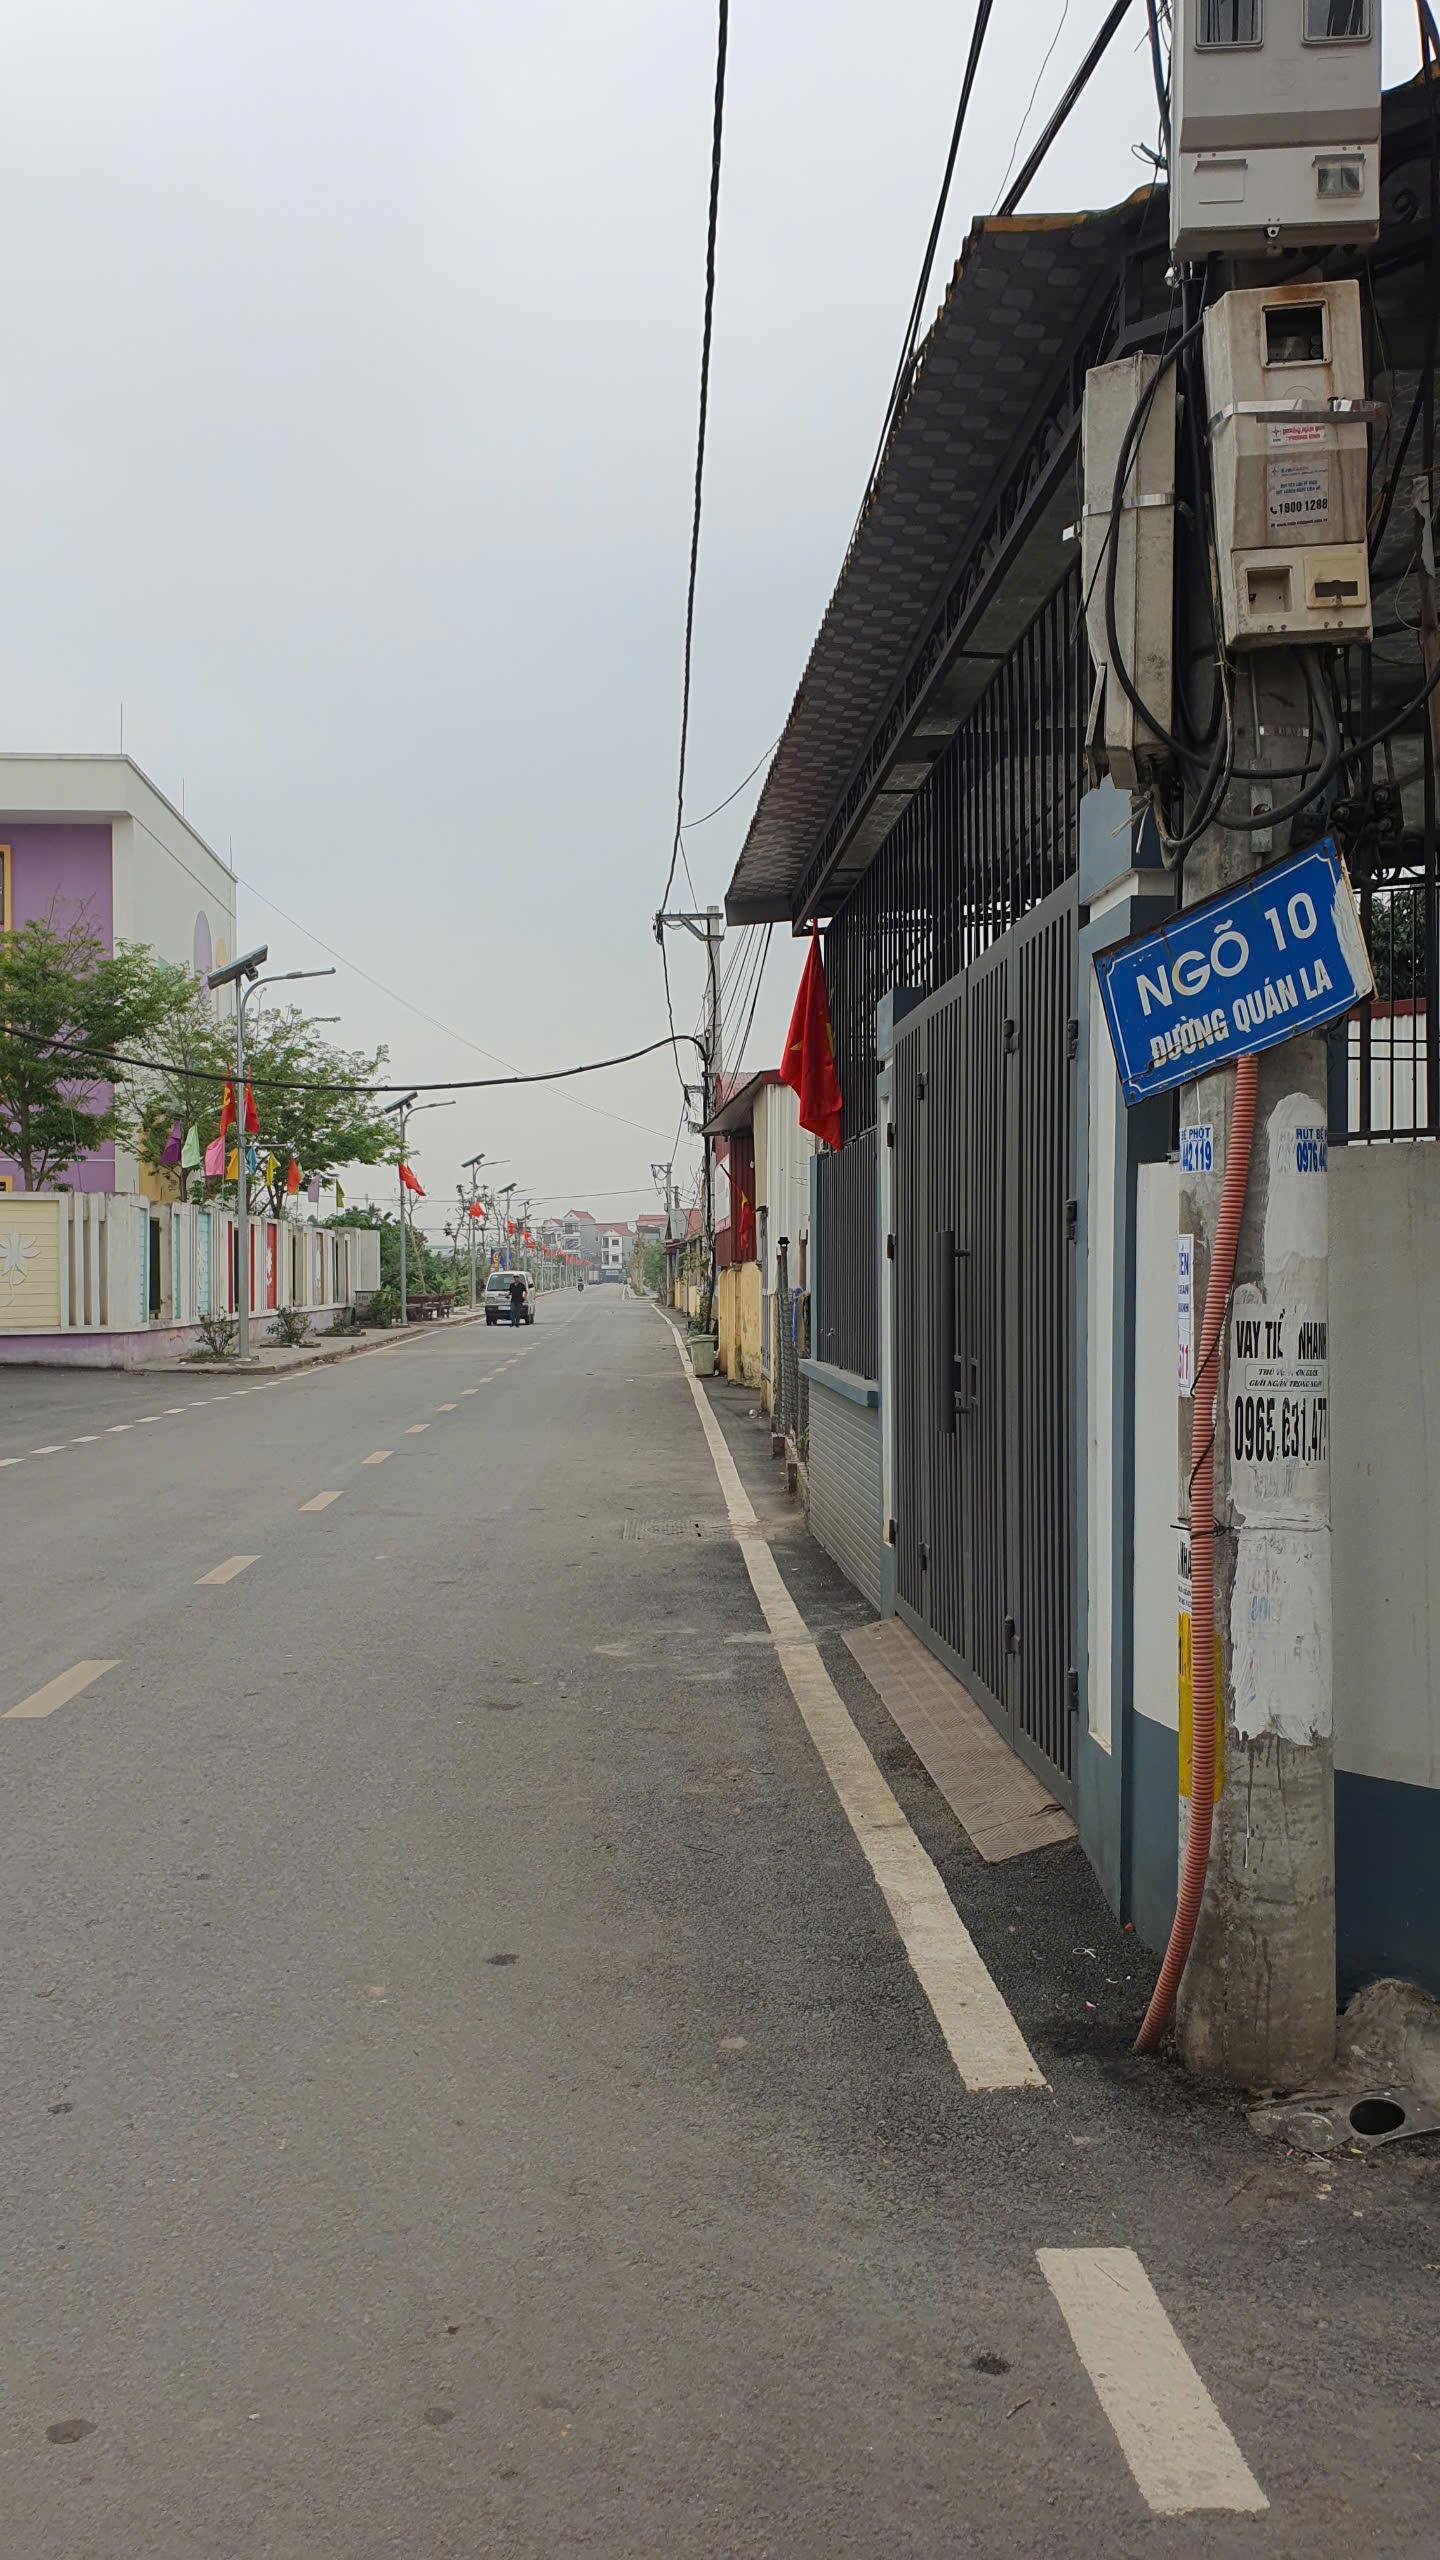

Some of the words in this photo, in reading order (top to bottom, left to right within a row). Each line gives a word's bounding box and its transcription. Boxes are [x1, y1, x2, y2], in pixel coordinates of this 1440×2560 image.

[1305, 498, 1328, 511] 1288
[1136, 919, 1249, 1016] NGÕ
[1264, 892, 1317, 951] 10
[1150, 1008, 1229, 1068] ĐƯỜNG
[1232, 974, 1298, 1033] QUÁN
[1299, 958, 1334, 1001] LA
[1236, 1320, 1261, 1359] VAY
